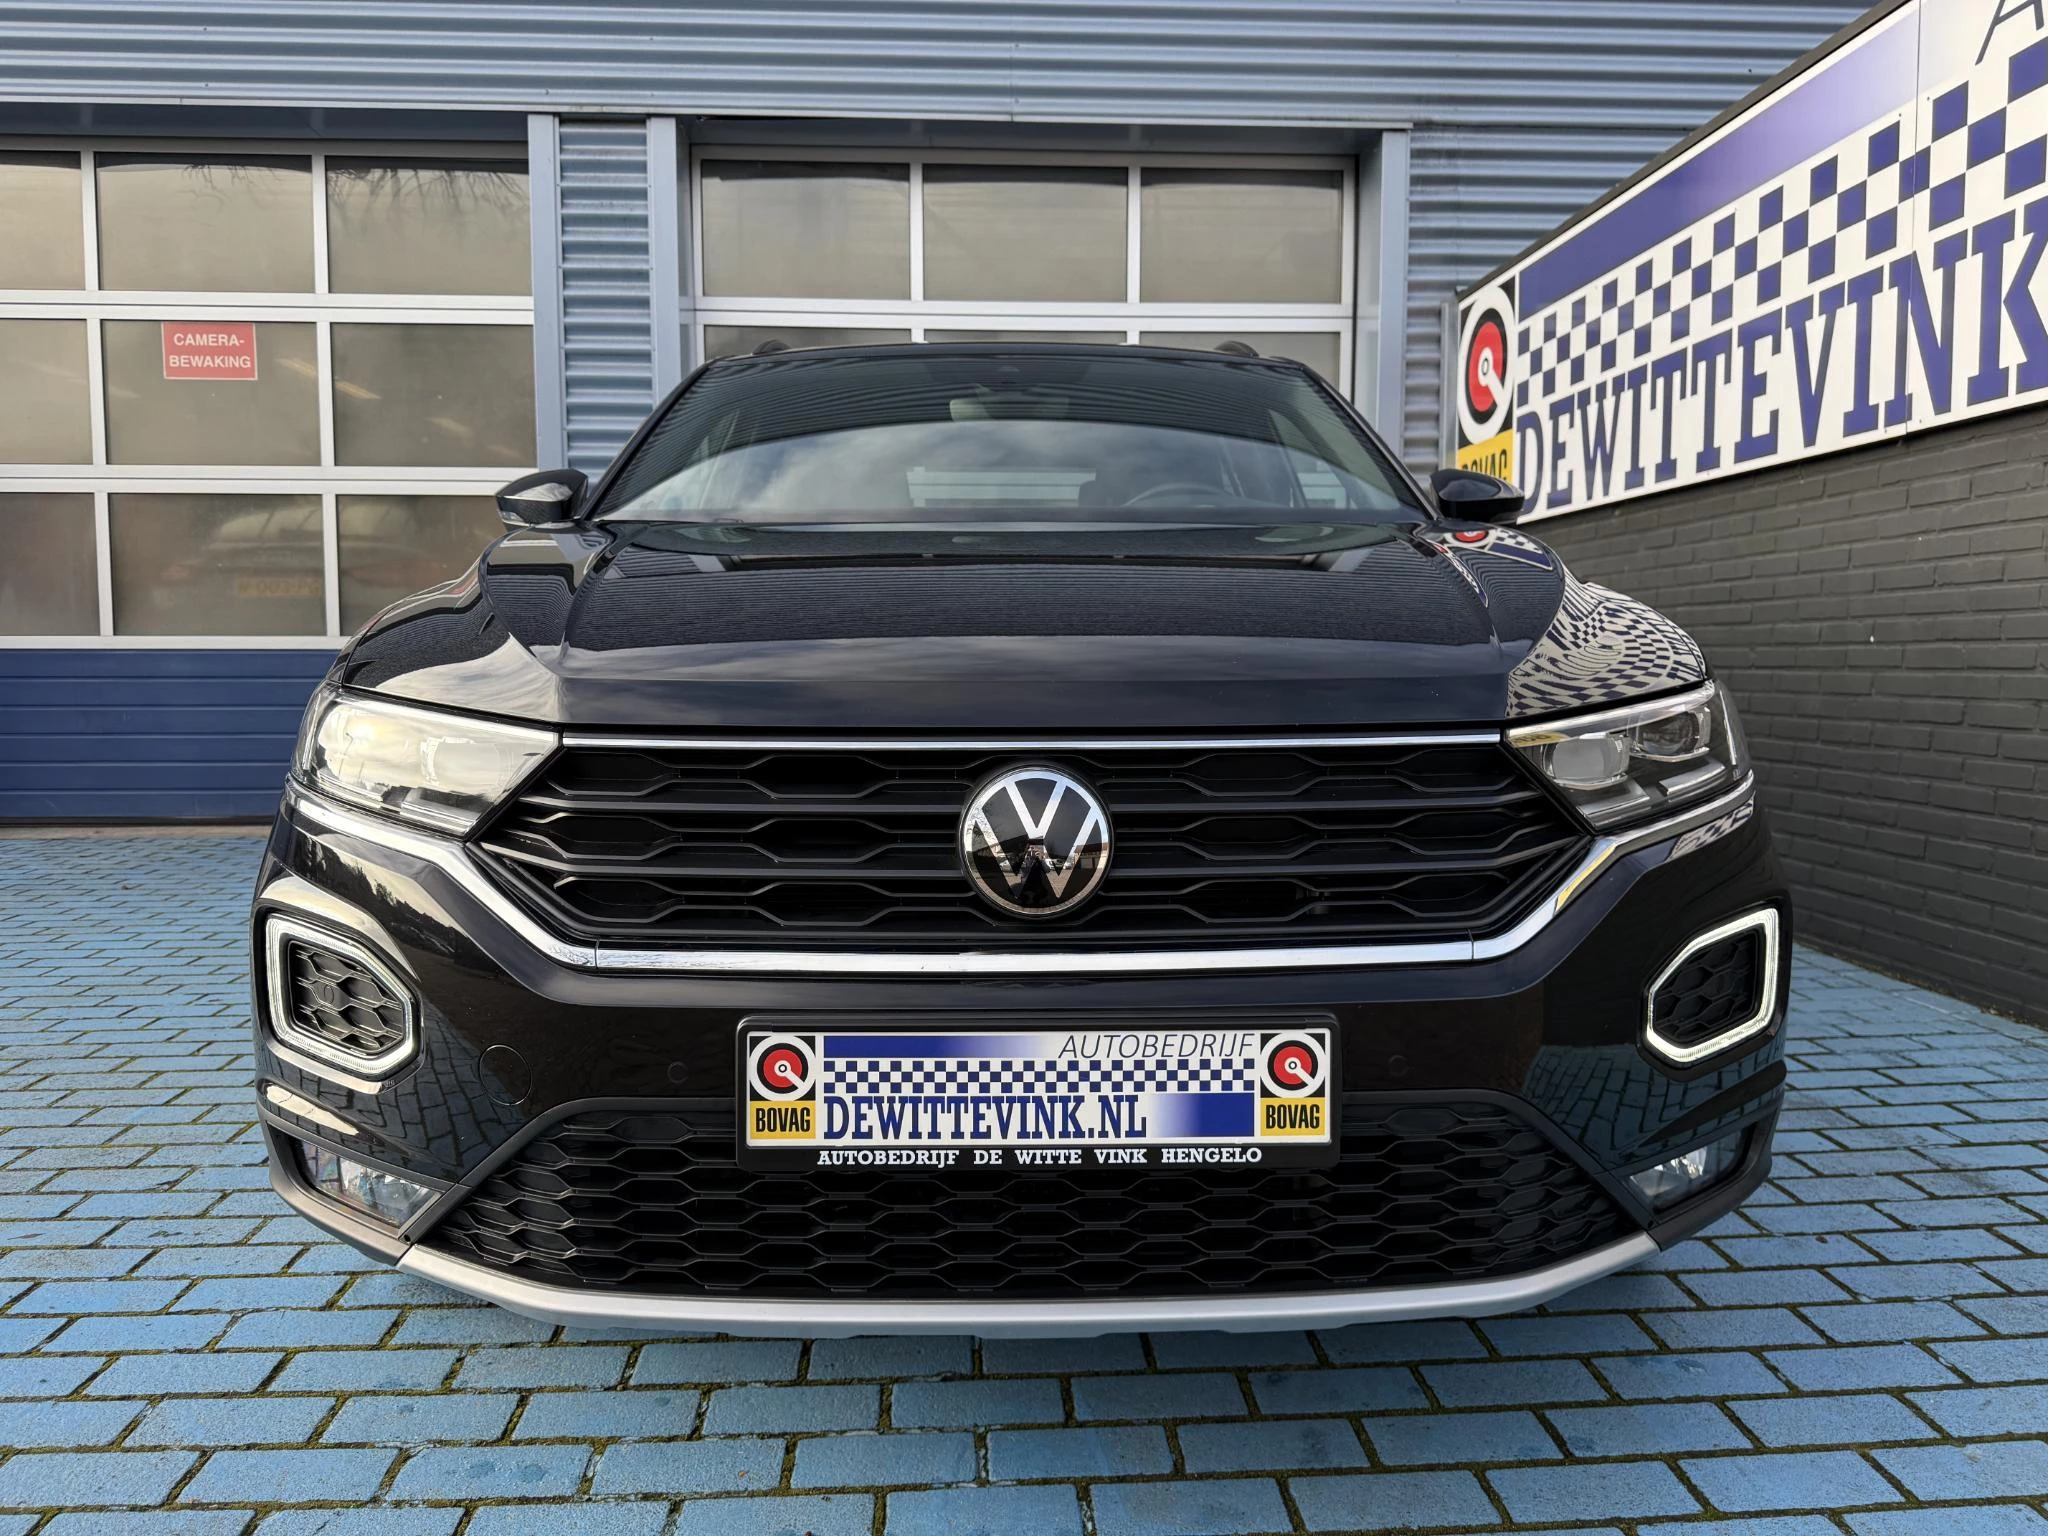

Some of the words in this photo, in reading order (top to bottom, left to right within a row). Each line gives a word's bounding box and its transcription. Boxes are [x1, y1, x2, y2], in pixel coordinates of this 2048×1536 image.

[173, 333, 245, 346] CAMERA-
[169, 355, 251, 368] BEWAKING
[1058, 1033, 1255, 1059] AUTOBEDRIJF
[755, 1107, 811, 1133] BOVAG
[823, 1095, 1147, 1140] DEWITTEVINK.NL
[1265, 1104, 1320, 1129] BOVAG
[817, 1150, 960, 1168] AUTOBEDRIJF
[973, 1150, 1002, 1165] DE
[1015, 1149, 1082, 1165] WITTE
[1094, 1149, 1147, 1164] VINK
[1161, 1148, 1262, 1163] HENGELO
